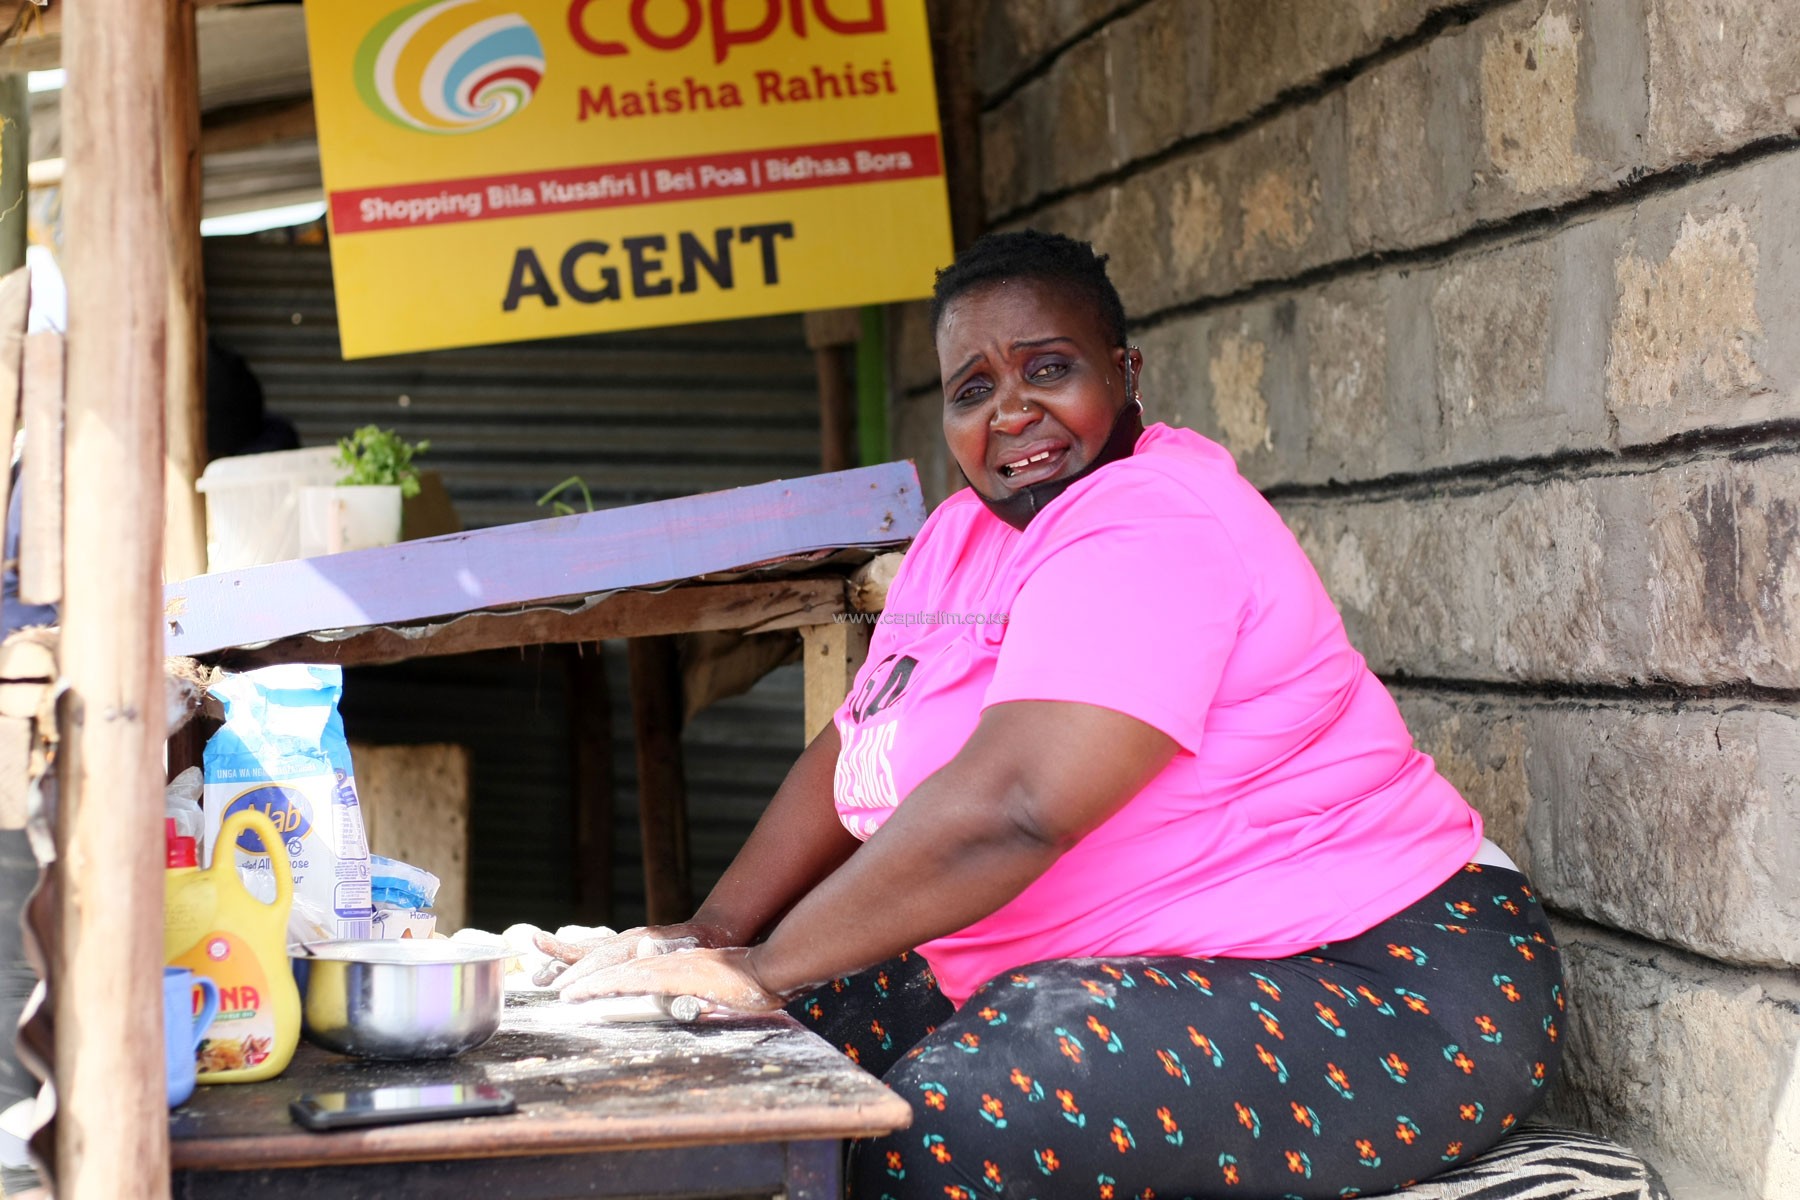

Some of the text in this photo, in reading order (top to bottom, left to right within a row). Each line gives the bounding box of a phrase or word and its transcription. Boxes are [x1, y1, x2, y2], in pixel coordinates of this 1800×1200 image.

[577, 59, 897, 122] Maisha Rahisi
[359, 190, 483, 223] Shopping
[486, 184, 537, 210] Bila
[538, 172, 637, 204] Kusafiri
[654, 166, 696, 193] Bei
[699, 164, 748, 188] Poa
[764, 154, 852, 182] Bidhaa
[854, 149, 913, 174] Bora
[502, 221, 794, 312] AGENT
[217, 768, 237, 779] UNGA
[239, 766, 252, 778] WA
